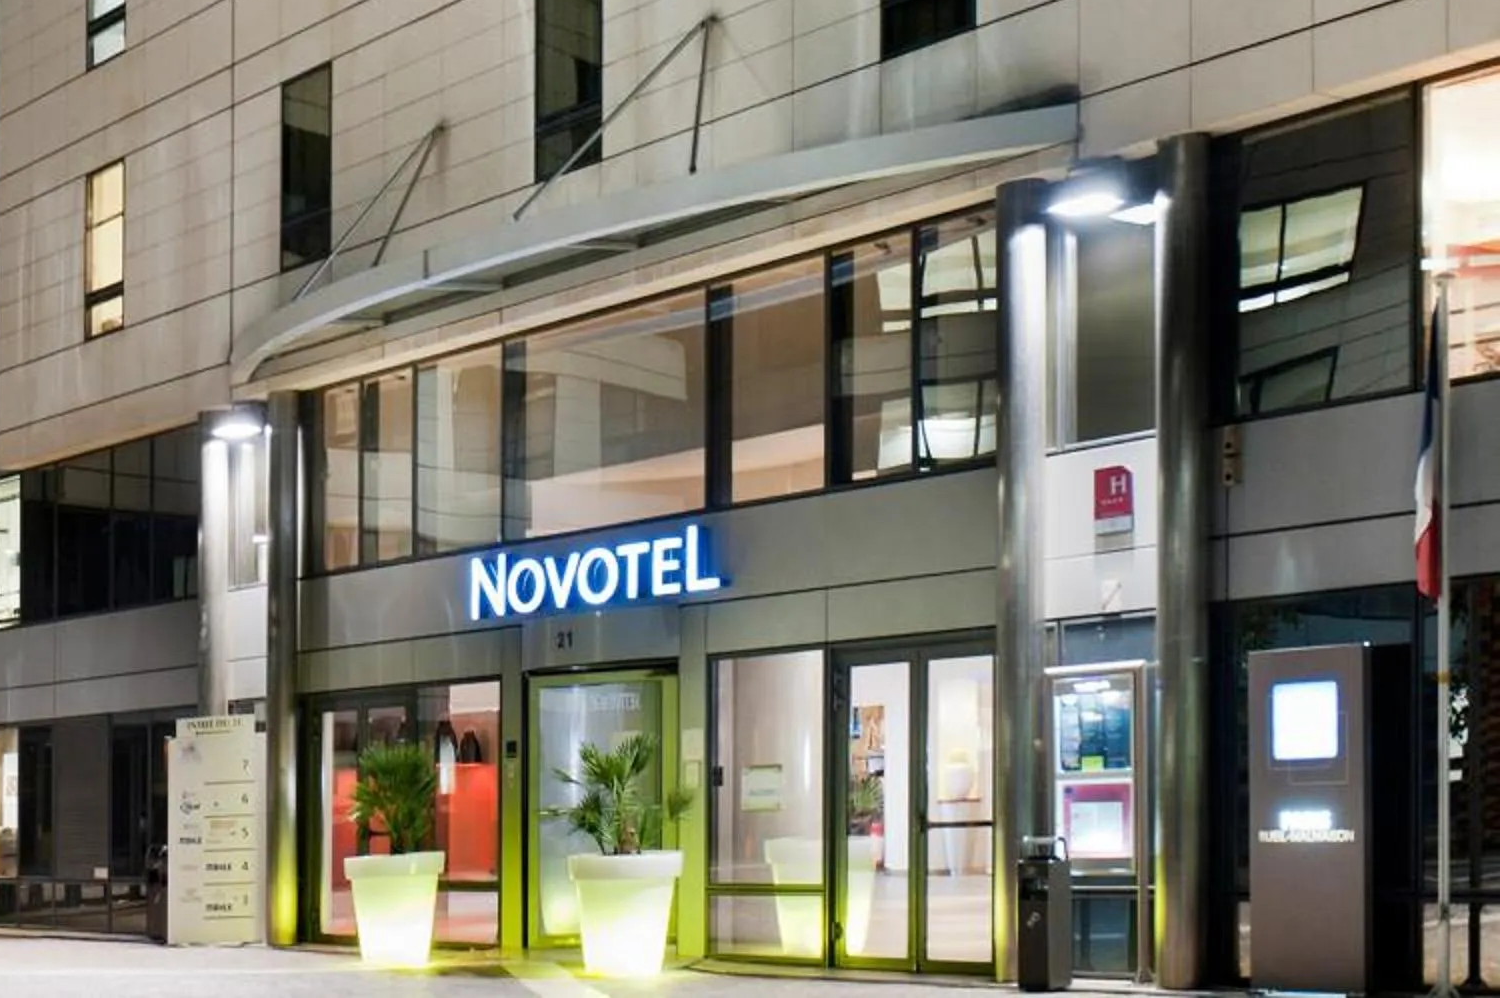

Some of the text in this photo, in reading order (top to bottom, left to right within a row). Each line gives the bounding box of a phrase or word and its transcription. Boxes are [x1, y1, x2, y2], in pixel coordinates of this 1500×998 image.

[1109, 474, 1127, 495] H
[470, 524, 721, 621] NOVOTEL
[557, 631, 573, 650] 21
